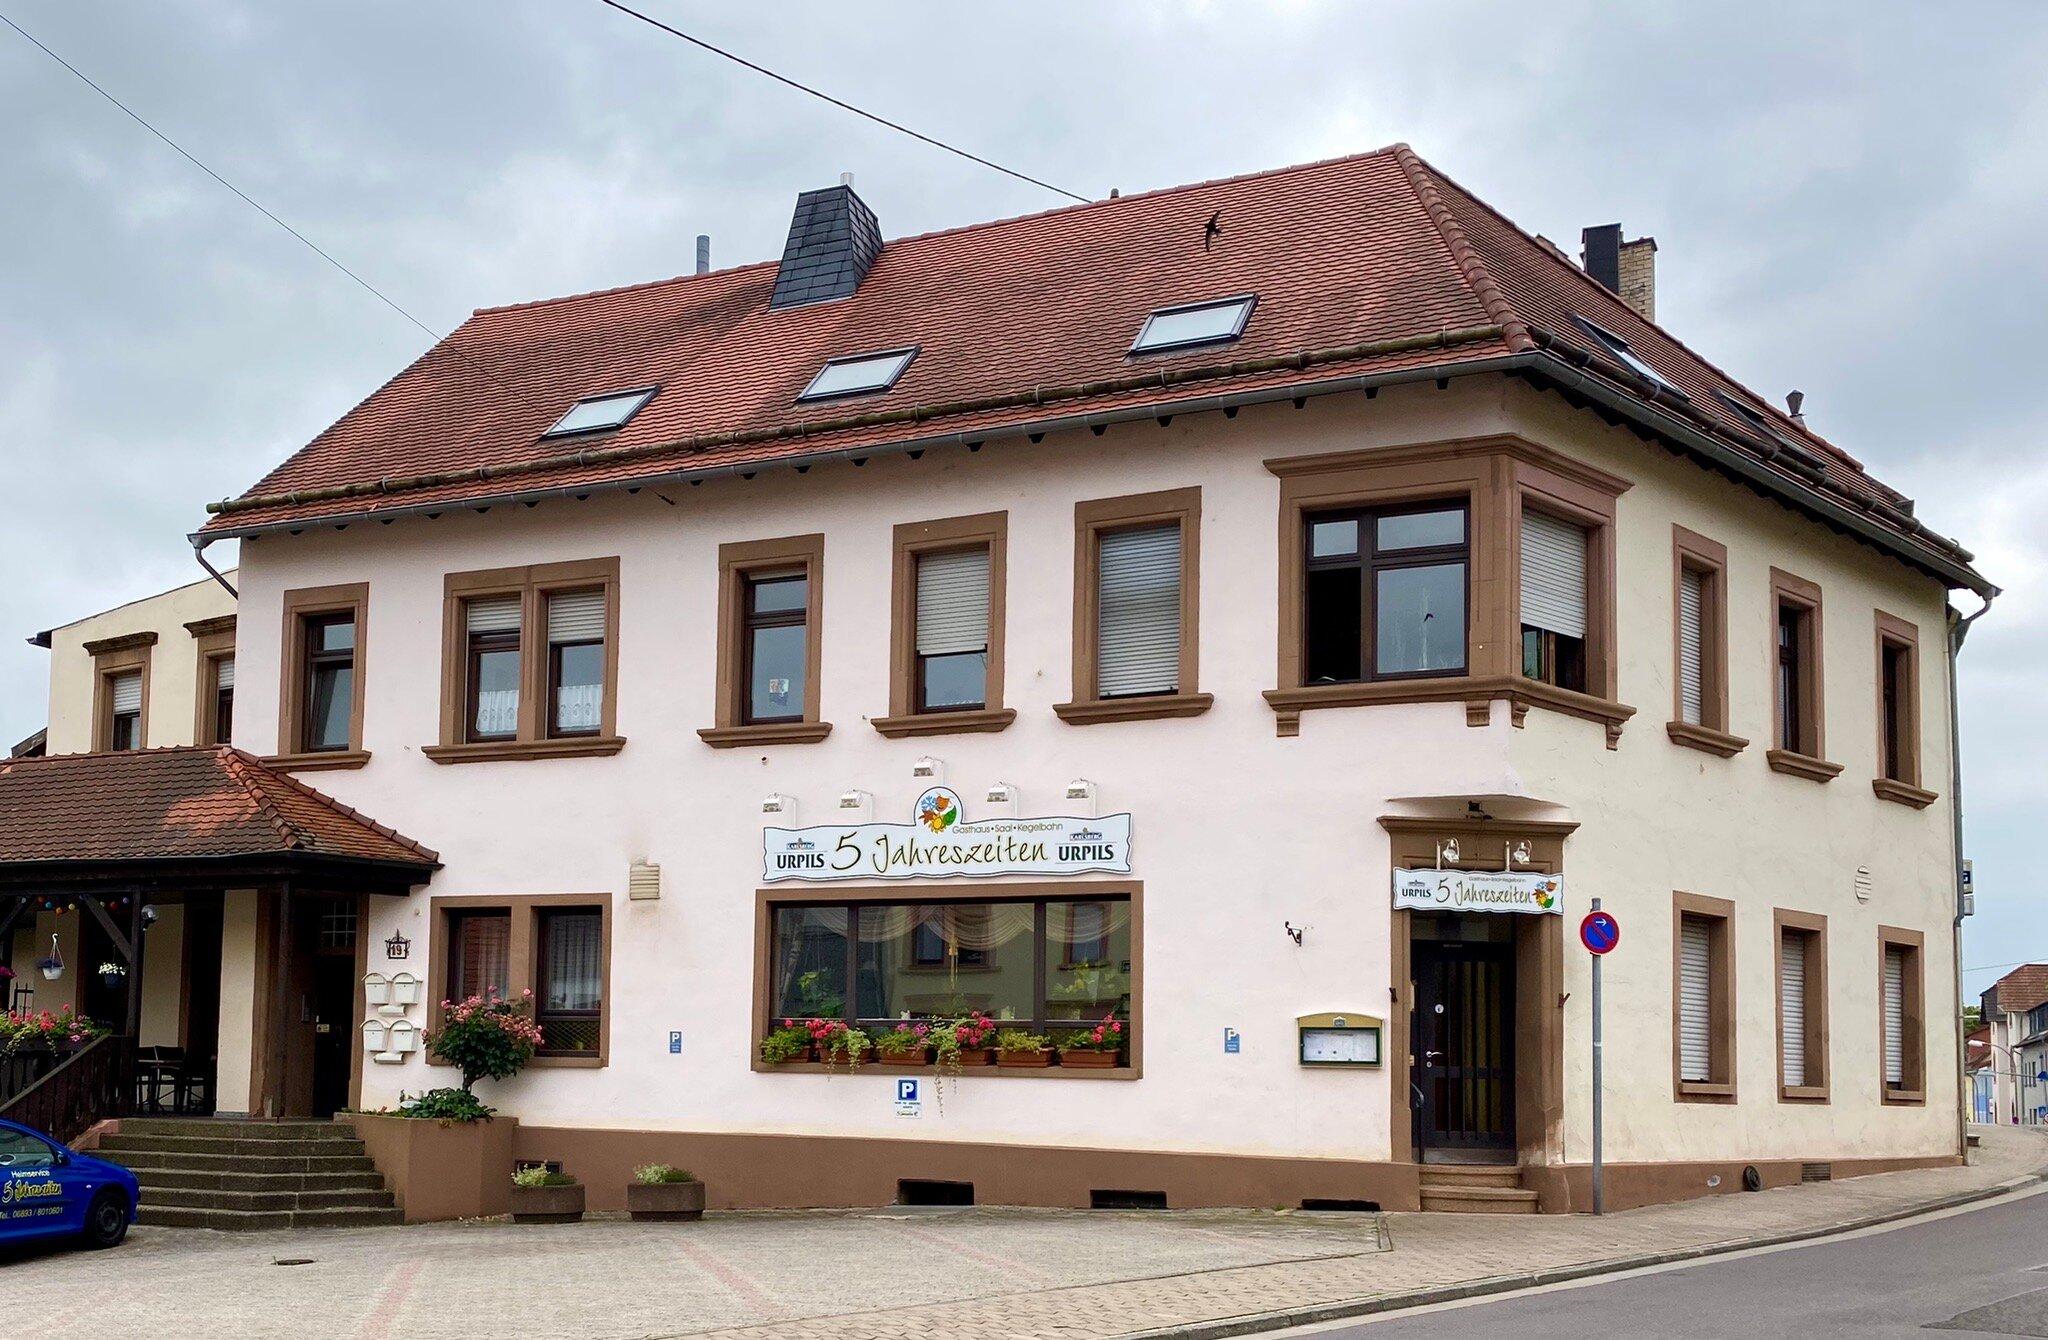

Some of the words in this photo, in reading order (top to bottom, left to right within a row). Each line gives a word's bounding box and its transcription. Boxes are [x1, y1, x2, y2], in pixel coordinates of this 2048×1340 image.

[831, 831, 861, 871] 5
[872, 834, 1048, 873] Jahreszeiten
[1059, 844, 1115, 861] URPILS
[776, 853, 825, 869] URPILS
[1401, 888, 1432, 898] URPILS
[1435, 878, 1451, 903] 5
[1454, 880, 1532, 906] Jahreszeiten
[391, 944, 402, 956] 19
[672, 1032, 680, 1043] P
[1228, 1029, 1236, 1041] P
[901, 1082, 914, 1098] P
[1, 1180, 14, 1203] 5
